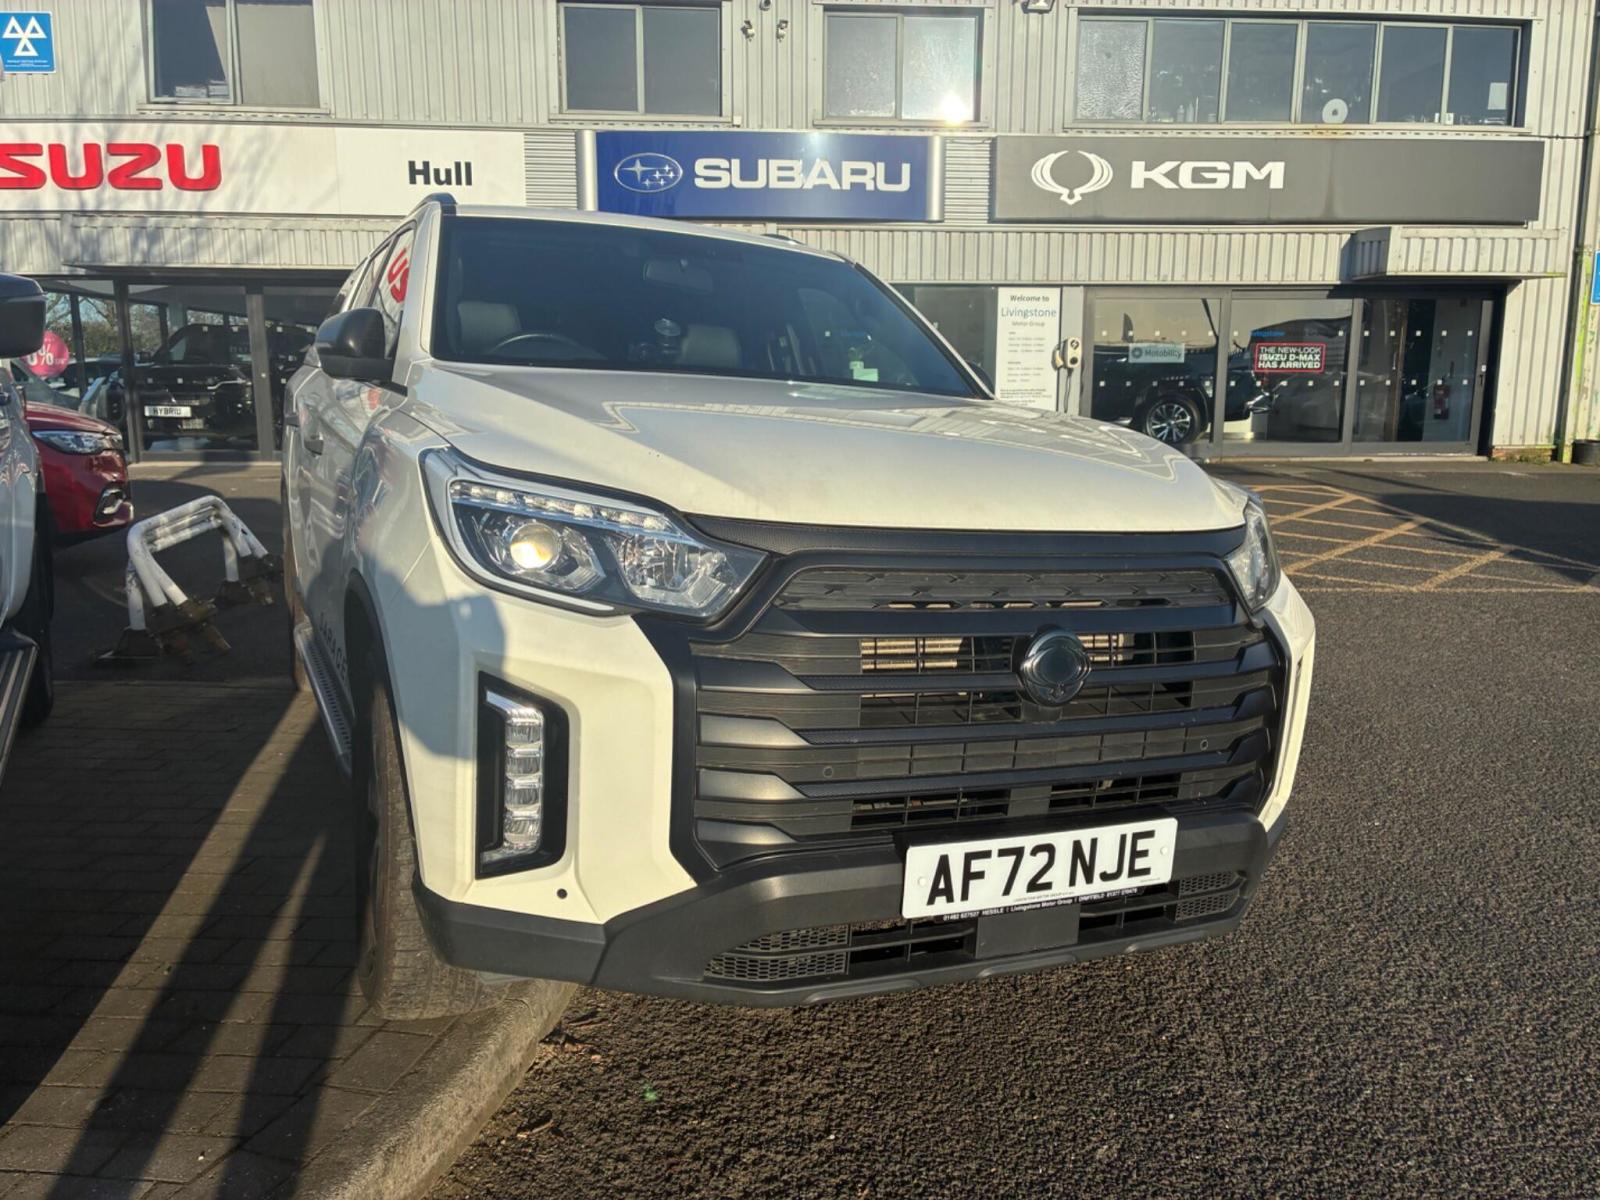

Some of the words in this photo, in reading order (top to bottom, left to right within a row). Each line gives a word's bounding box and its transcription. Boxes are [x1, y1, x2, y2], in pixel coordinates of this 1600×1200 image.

[408, 160, 472, 186] Hull
[694, 158, 911, 192] SUBARU
[1131, 161, 1285, 189] KGM
[1010, 294, 1041, 302] Welcome
[1001, 307, 1057, 319] Livingstone
[1260, 346, 1276, 354] THE
[1278, 346, 1322, 354] NEW-LOOK
[1259, 353, 1287, 361] ISUZU
[1288, 353, 1321, 361] D-MAX
[1258, 361, 1278, 369] HAS
[1279, 361, 1321, 369] ARRIVED
[926, 843, 1057, 906] AF72
[1069, 830, 1156, 887] NJE
[1010, 903, 1041, 913] Livingstone
[1041, 901, 1056, 909] Motor
[1056, 898, 1073, 906] Group
